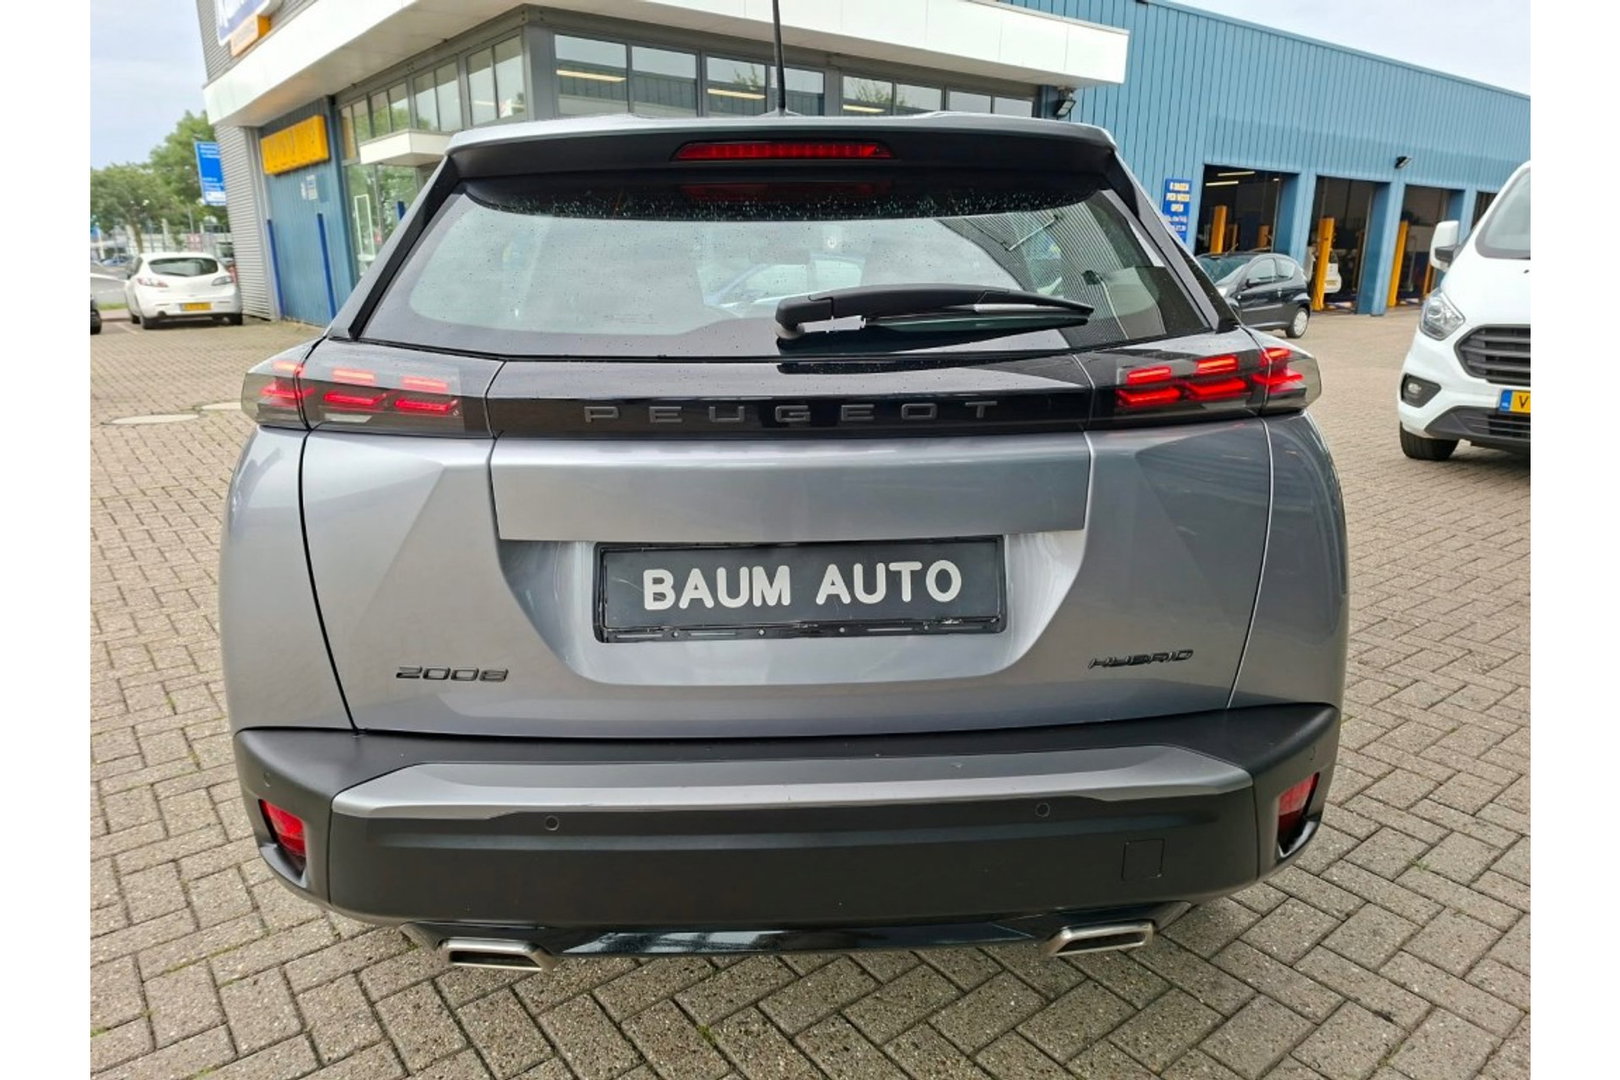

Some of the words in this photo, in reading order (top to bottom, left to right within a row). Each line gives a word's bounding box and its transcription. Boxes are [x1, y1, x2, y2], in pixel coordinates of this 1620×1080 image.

[583, 400, 998, 423] PEUGEOT
[643, 564, 791, 610] BAUM
[816, 559, 962, 605] AUTO
[1088, 649, 1194, 670] HYBRID
[396, 666, 509, 682] 2008
